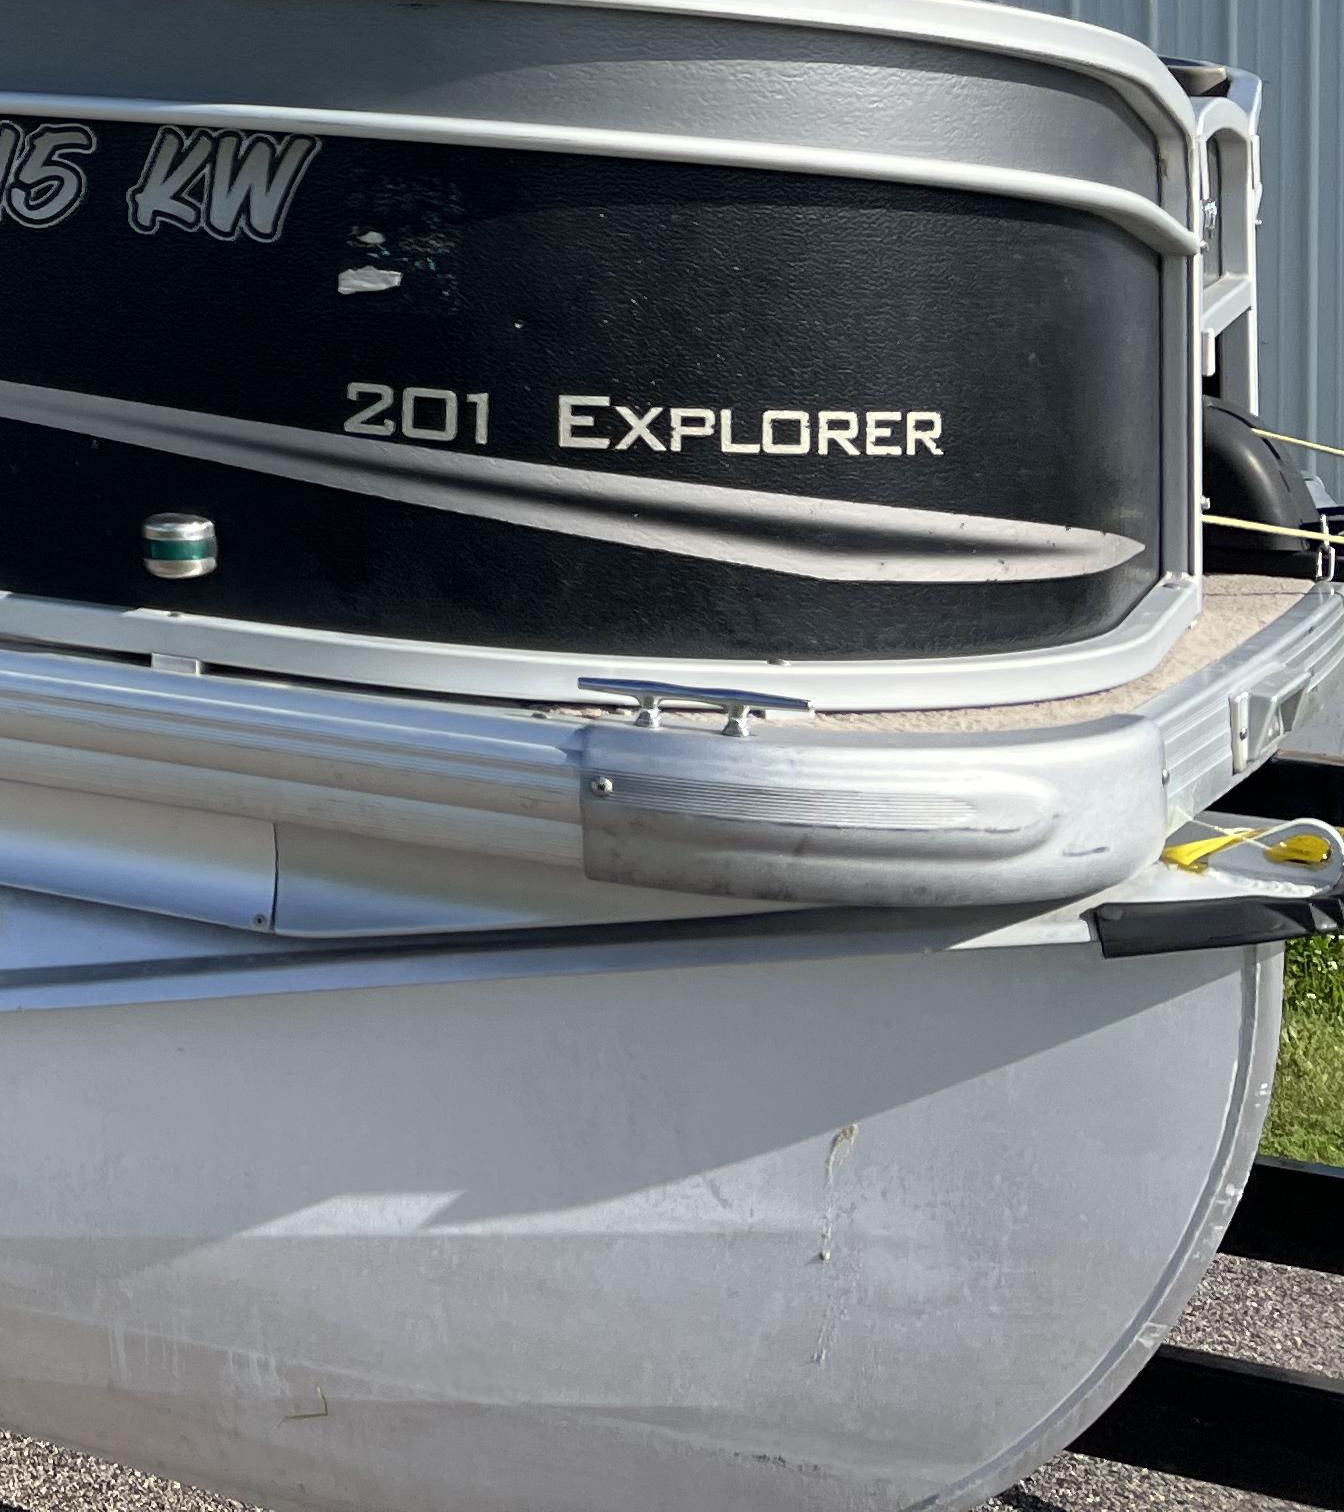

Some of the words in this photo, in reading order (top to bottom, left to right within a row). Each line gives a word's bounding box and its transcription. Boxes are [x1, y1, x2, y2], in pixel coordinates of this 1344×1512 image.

[127, 125, 322, 242] KW
[343, 382, 490, 445] 201
[557, 394, 945, 456] EXPLORER
